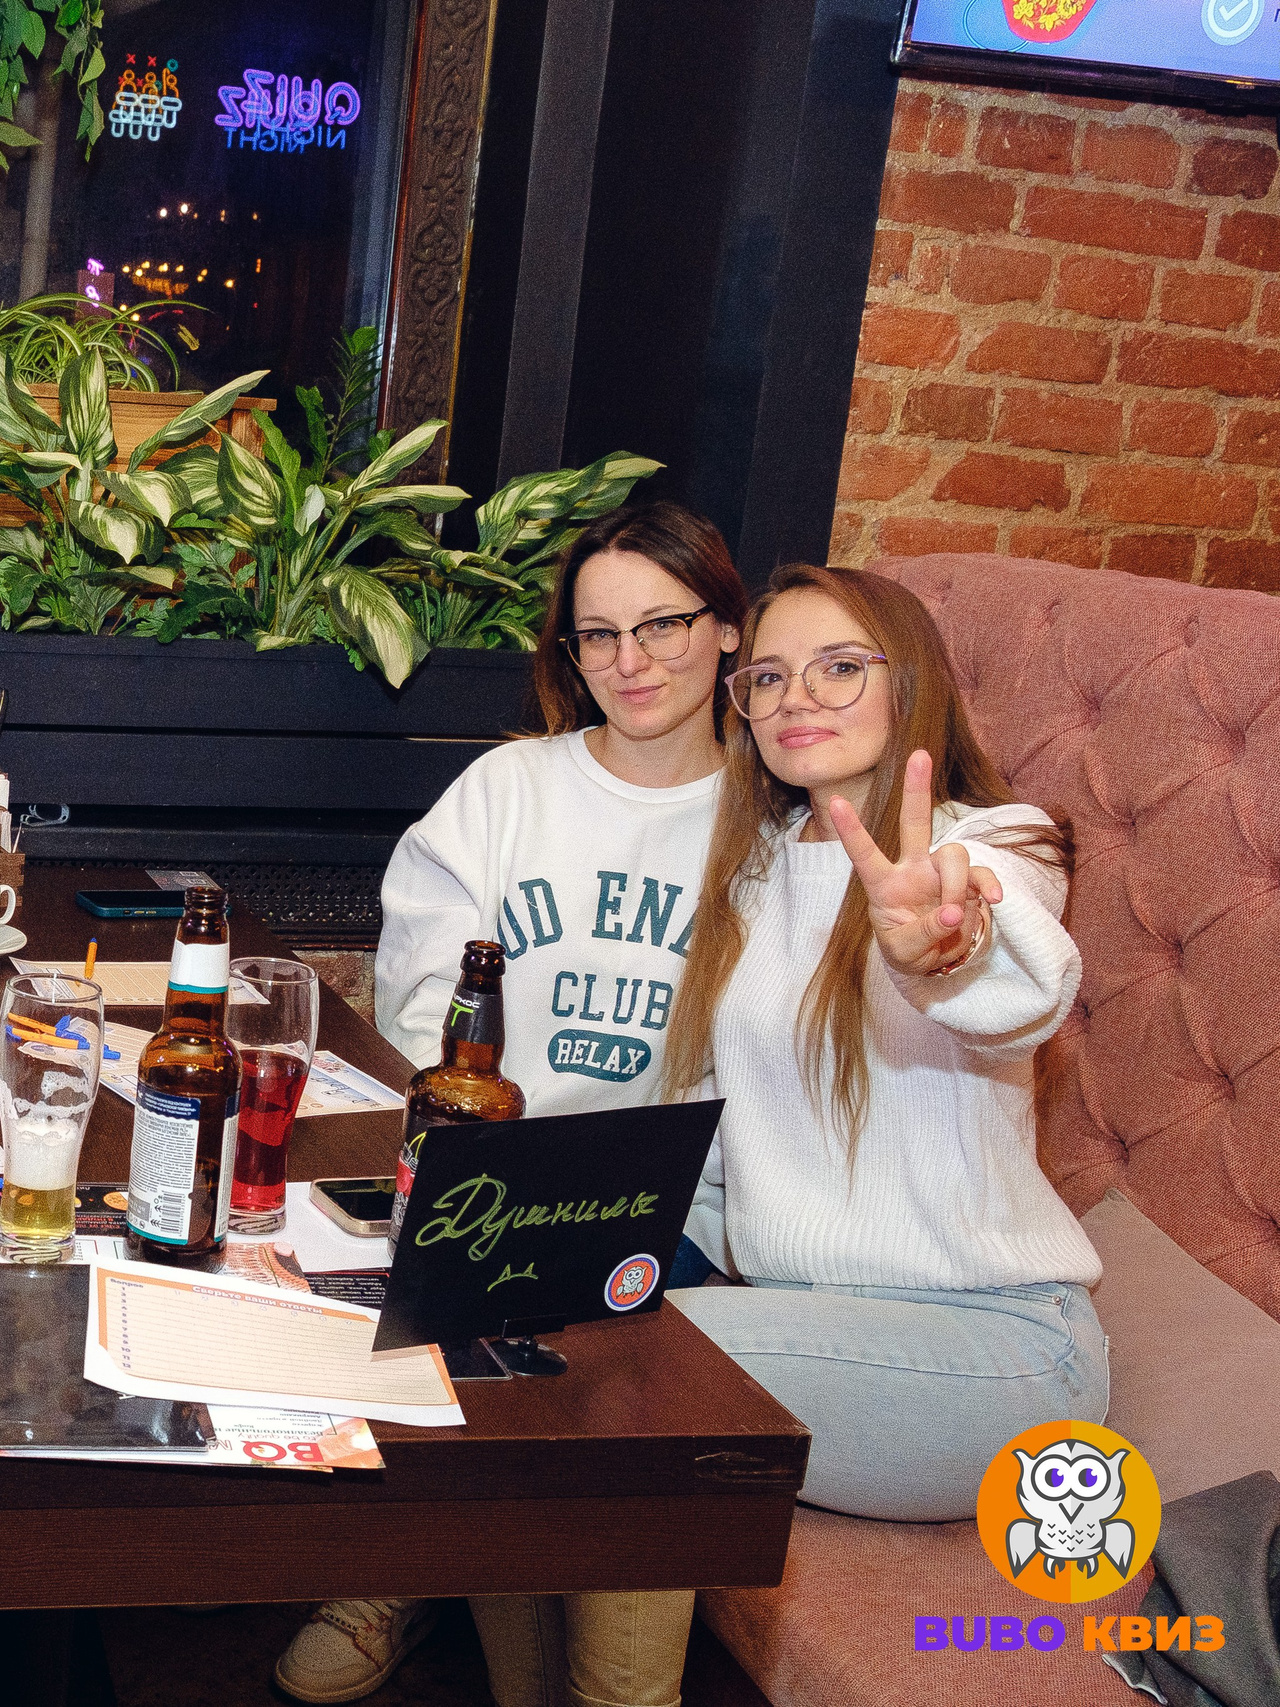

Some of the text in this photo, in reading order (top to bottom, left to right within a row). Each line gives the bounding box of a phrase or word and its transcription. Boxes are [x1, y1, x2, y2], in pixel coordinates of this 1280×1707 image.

[551, 970, 674, 1031] CLUB
[554, 1038, 646, 1075] RELAX
[240, 1440, 325, 1462] BQ
